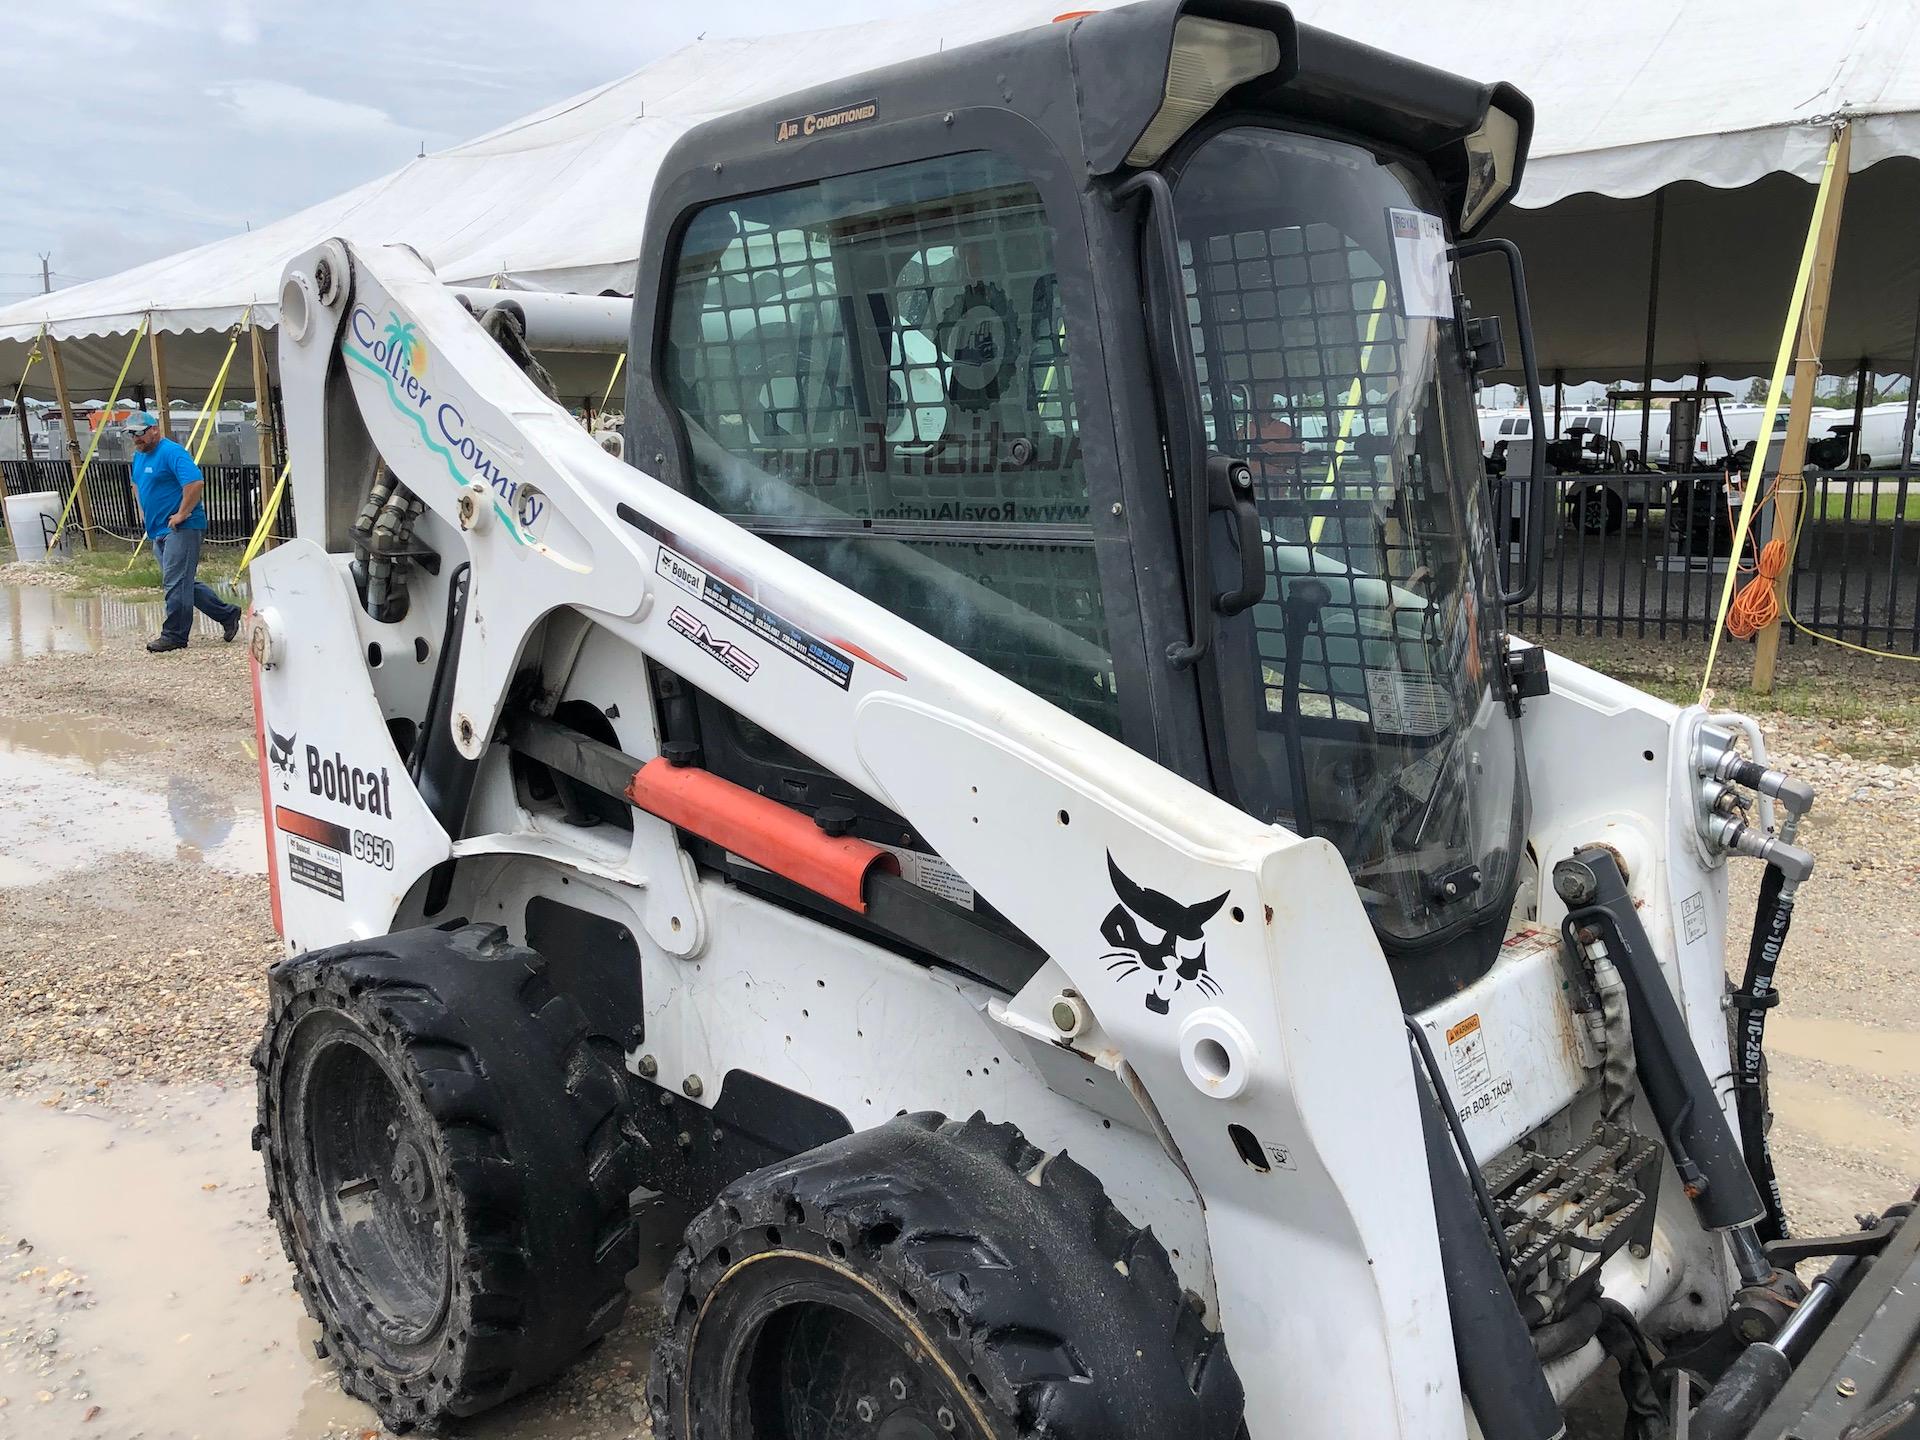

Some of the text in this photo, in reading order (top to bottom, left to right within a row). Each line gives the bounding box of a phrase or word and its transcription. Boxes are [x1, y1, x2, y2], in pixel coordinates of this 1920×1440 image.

[803, 114, 876, 136] CONDITIONED
[352, 308, 544, 527] Collier County
[672, 562, 700, 588] Bobcat
[682, 629, 750, 682] PERFORMANCE.COM
[306, 744, 392, 820] Bobcat
[353, 829, 395, 871] S650
[1749, 975, 1771, 1017] MSA
[1454, 1018, 1478, 1037] WARNING
[1459, 1078, 1514, 1123] ER BOB-TACH
